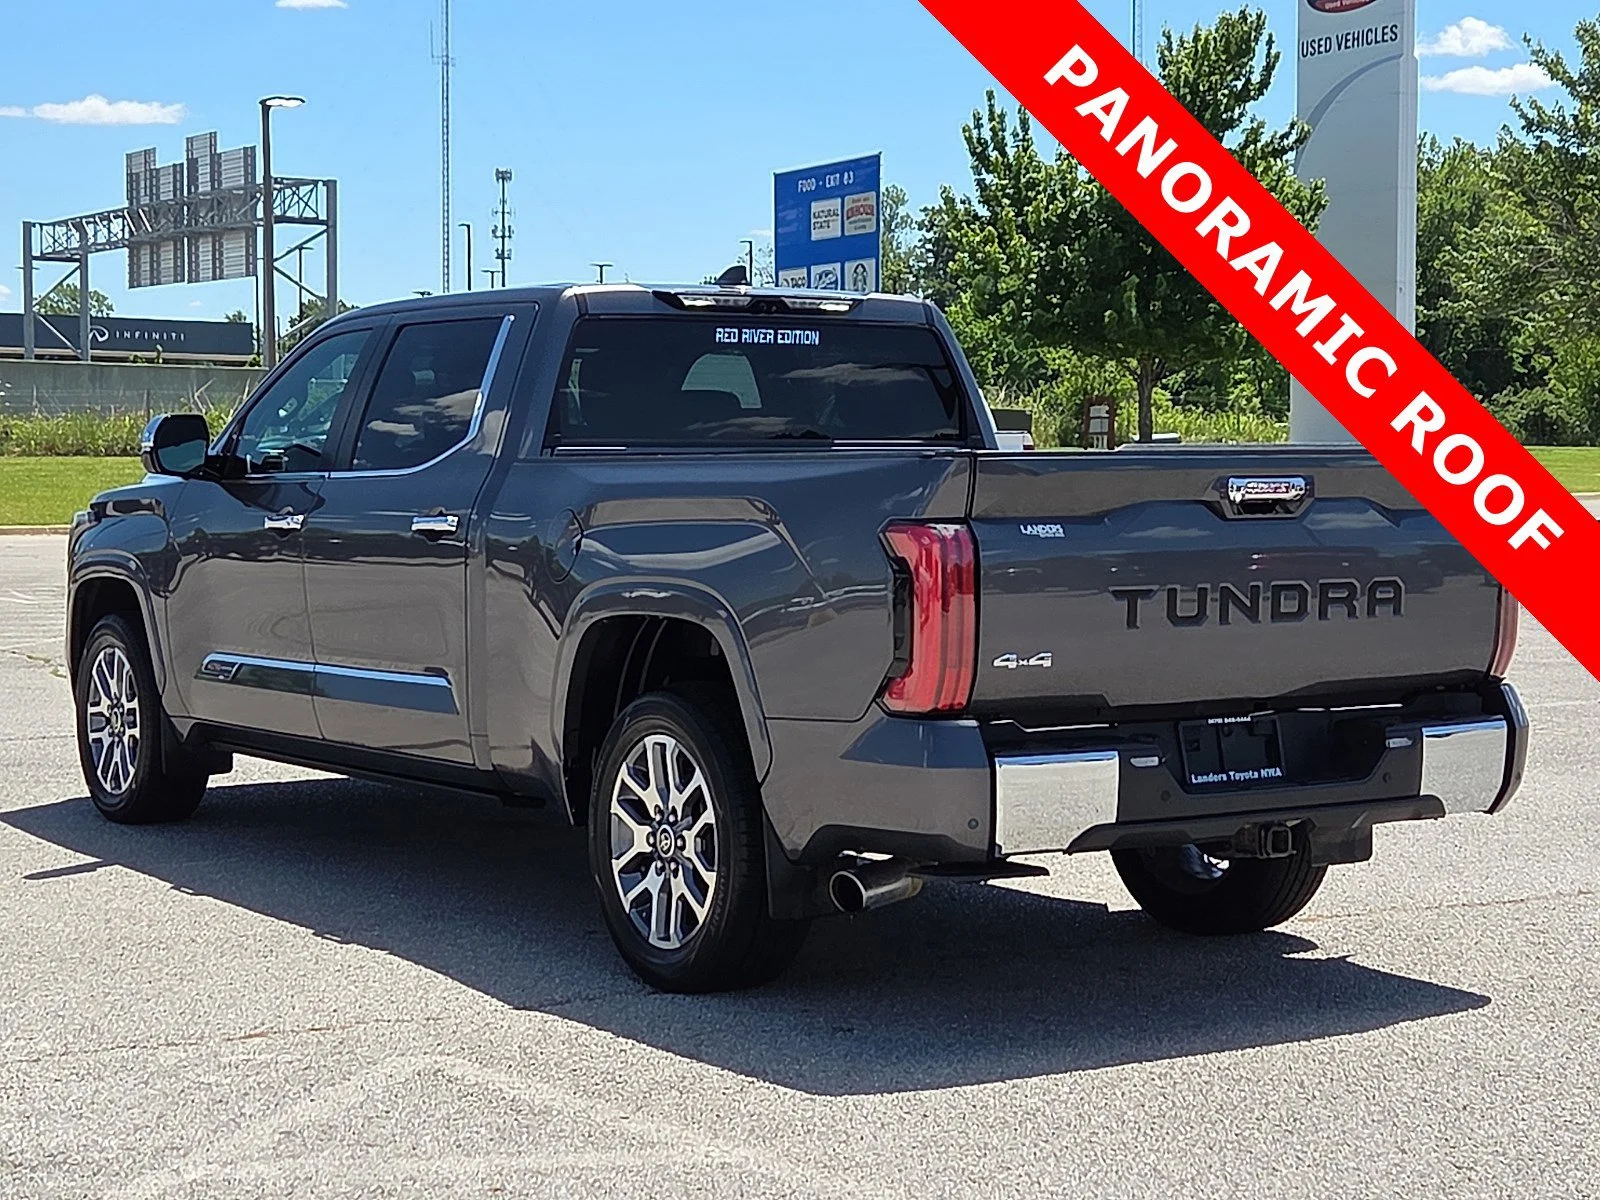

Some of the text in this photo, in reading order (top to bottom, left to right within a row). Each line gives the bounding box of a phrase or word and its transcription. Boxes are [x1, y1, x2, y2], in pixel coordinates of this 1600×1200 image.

[1301, 24, 1399, 58] USED VEHICLES
[797, 178, 816, 193] FOOD
[825, 172, 840, 188] EXIT
[812, 207, 840, 219] NATURAL
[812, 220, 831, 231] STATE
[115, 329, 185, 342] INFINITI
[715, 327, 819, 346] RED RIVER EDITION
[1019, 523, 1064, 536] LANDERS
[1108, 576, 1405, 630] TUNDRA
[1191, 773, 1227, 784] Landers
[1228, 770, 1259, 781] Toyota
